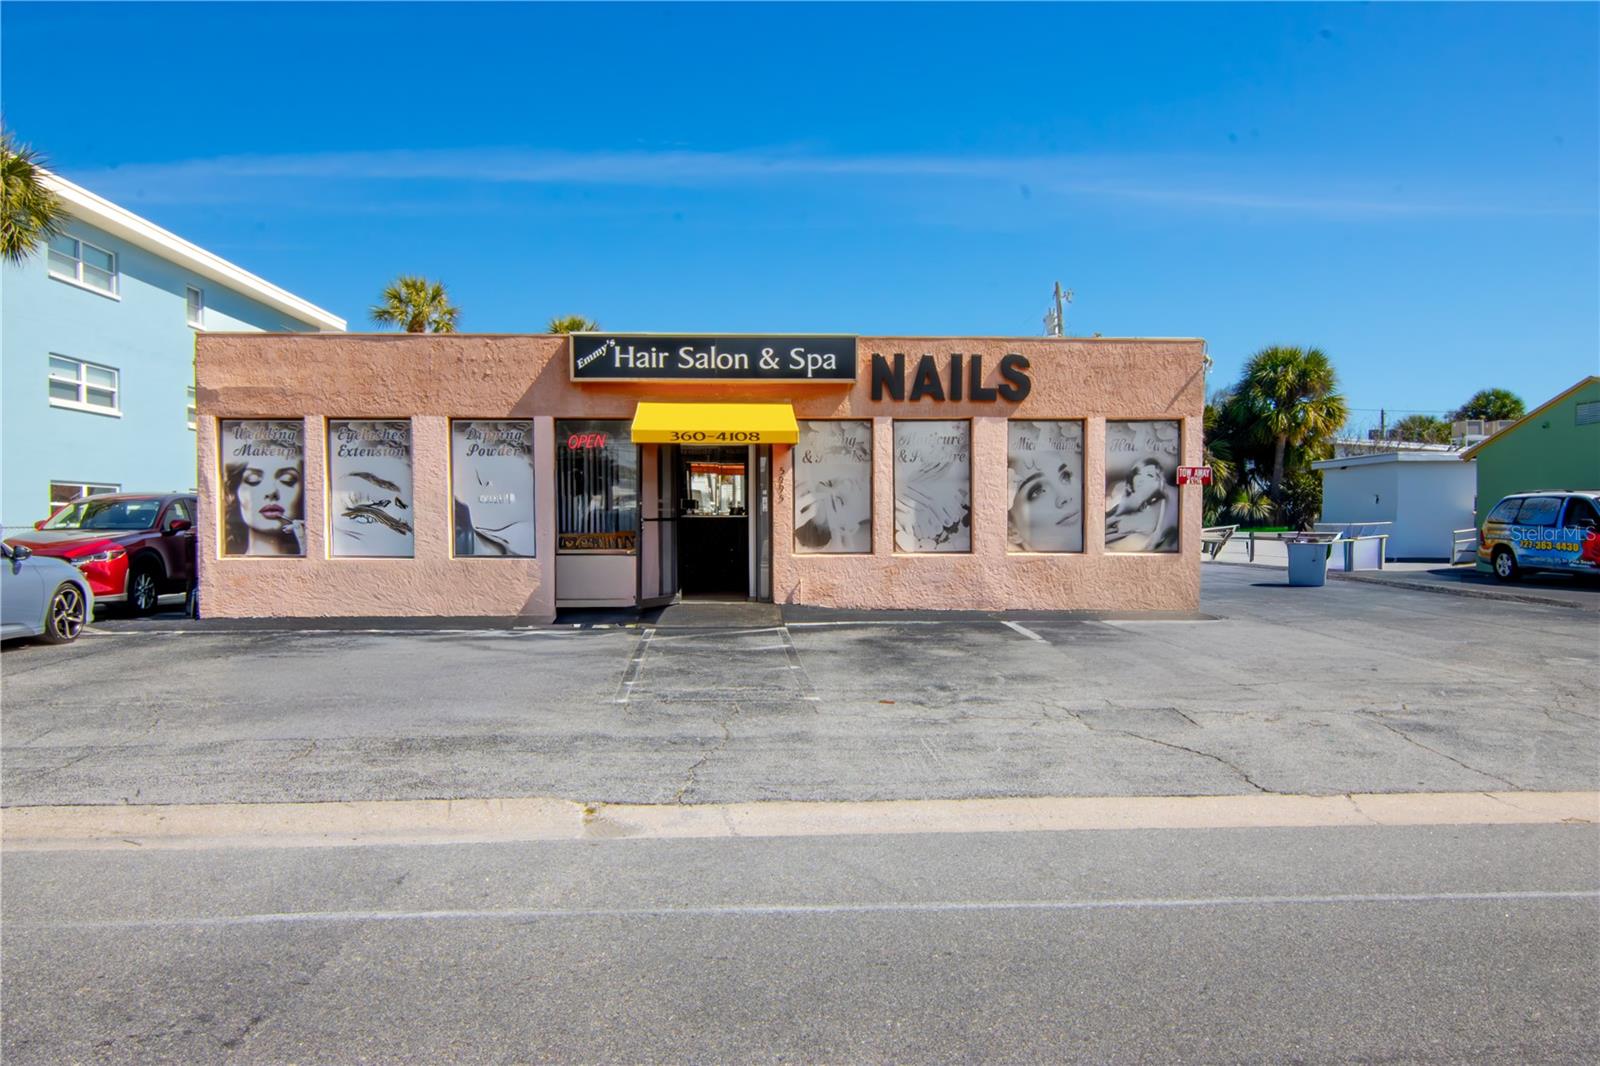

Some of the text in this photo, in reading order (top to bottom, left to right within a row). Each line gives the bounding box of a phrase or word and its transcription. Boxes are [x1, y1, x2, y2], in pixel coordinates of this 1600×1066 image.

[576, 339, 616, 369] Emmy's
[614, 346, 837, 378] Hair Salon & Spa
[871, 352, 1032, 402] NAILS
[567, 433, 608, 449] OPEN
[670, 431, 761, 442] 360-4108
[1179, 468, 1192, 478] TOW
